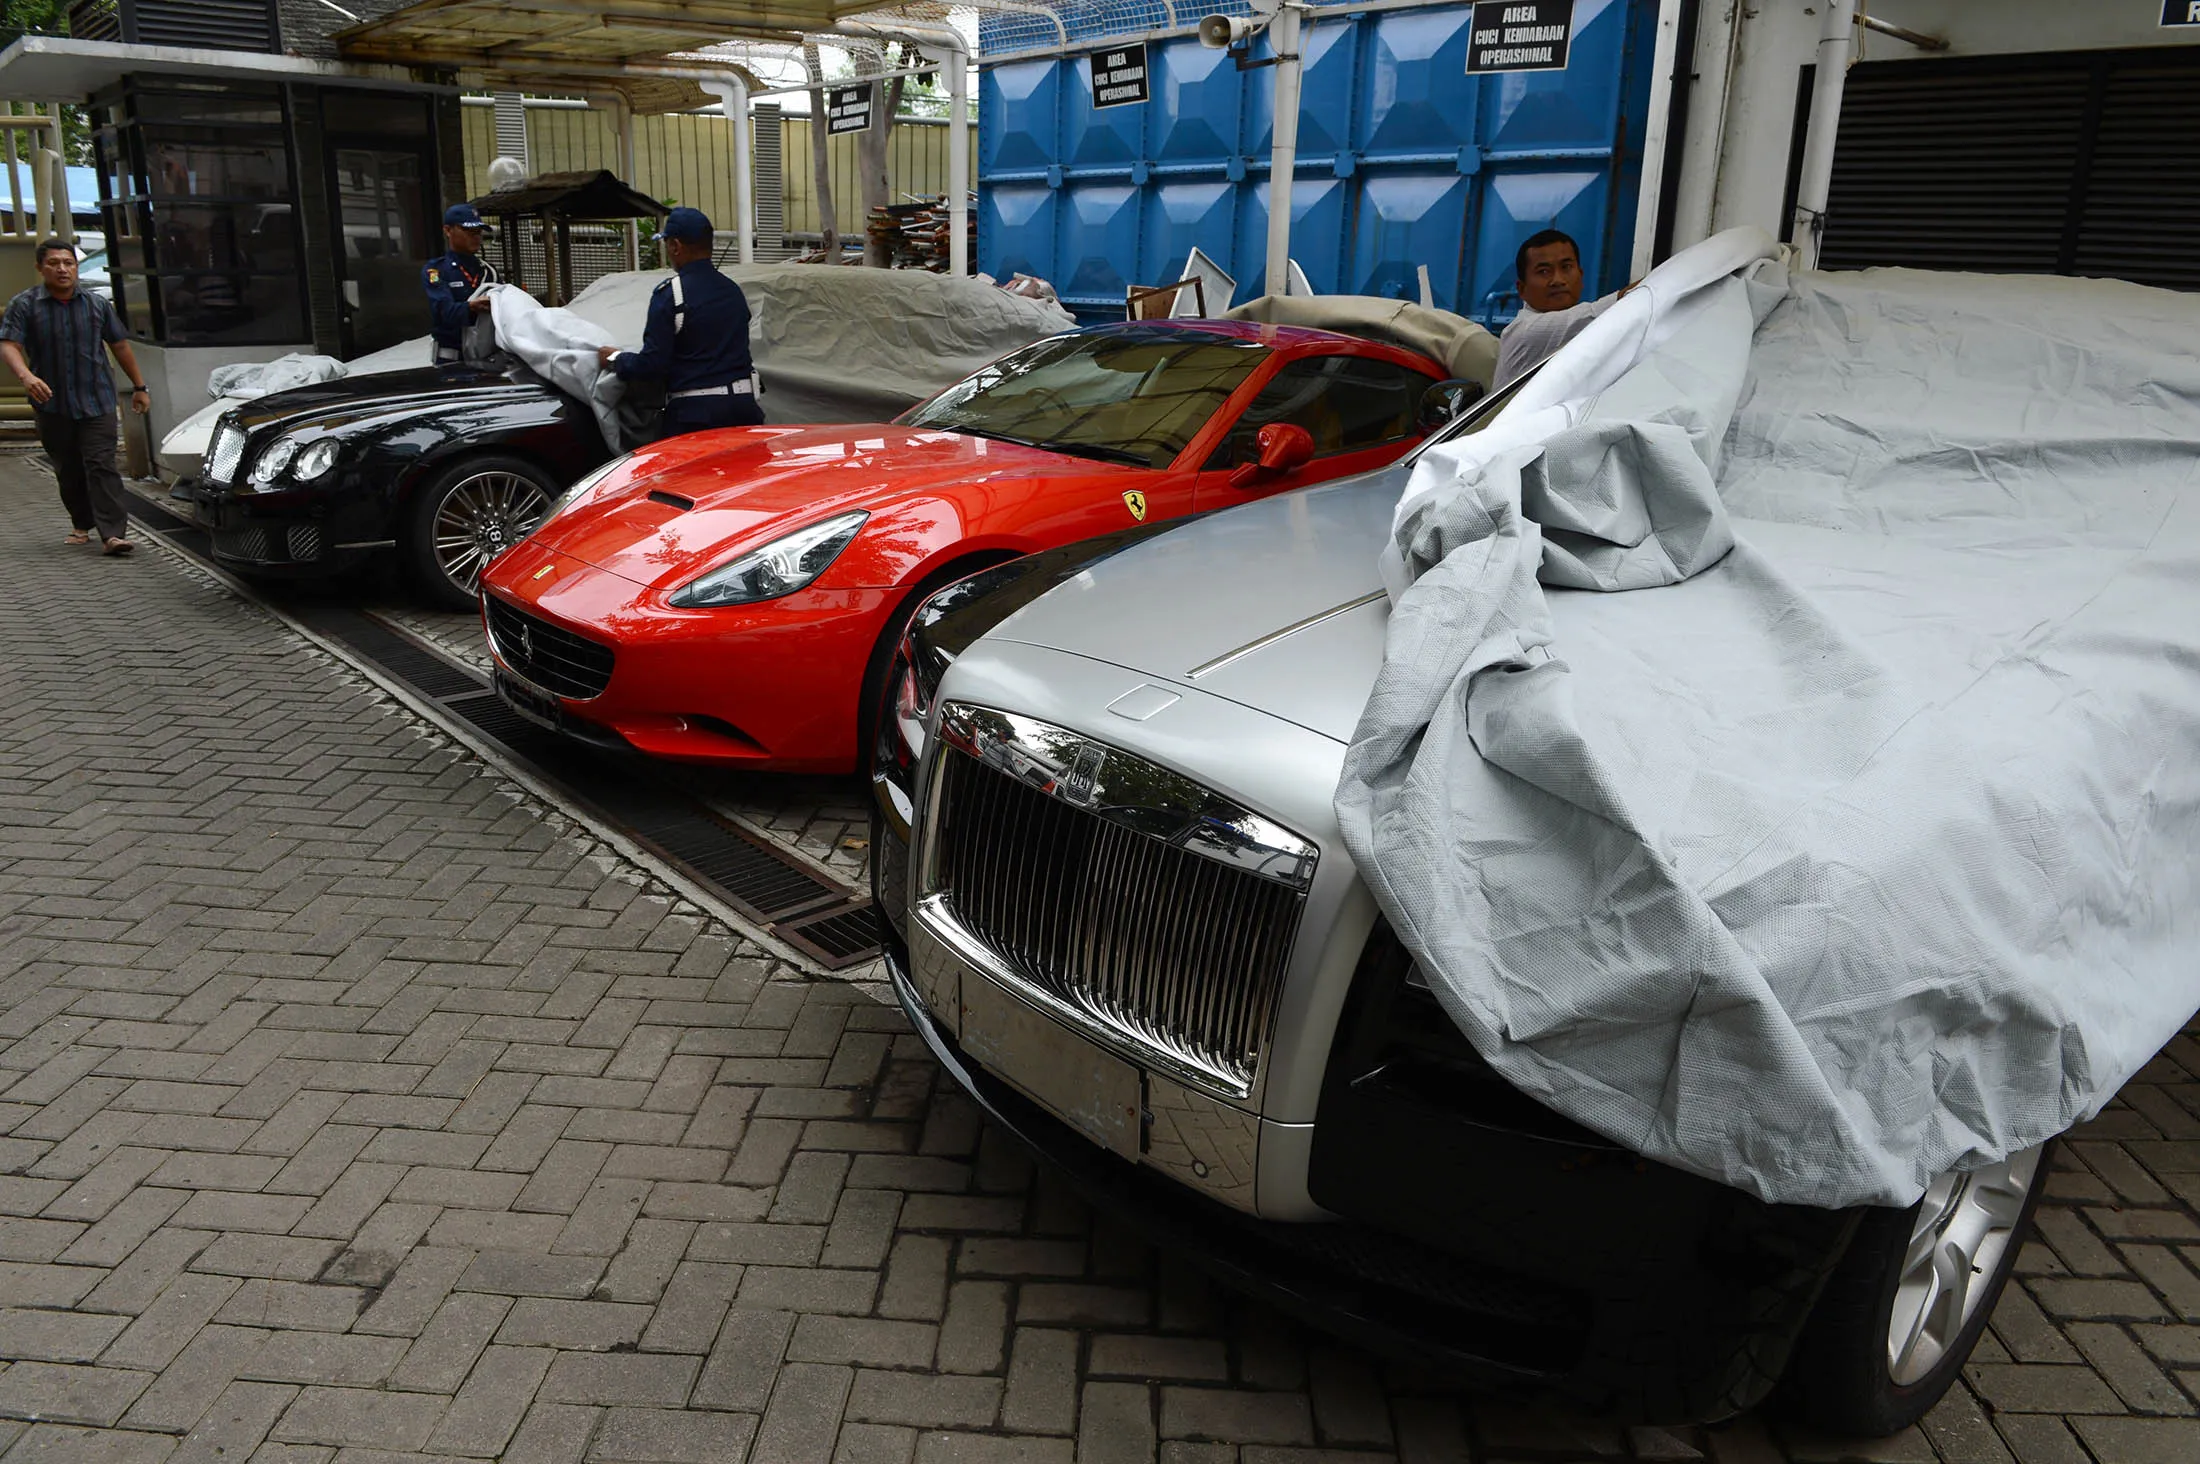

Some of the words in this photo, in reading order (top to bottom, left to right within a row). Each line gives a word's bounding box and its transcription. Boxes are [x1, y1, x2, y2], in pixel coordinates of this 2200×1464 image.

[1502, 6, 1537, 23] AREA
[1475, 29, 1499, 45] CUCI
[1504, 25, 1565, 43] KENDARAAN
[1108, 53, 1126, 67] AREA
[1480, 47, 1552, 65] OPERASIONAL
[1100, 84, 1140, 102] OPERASIONAL
